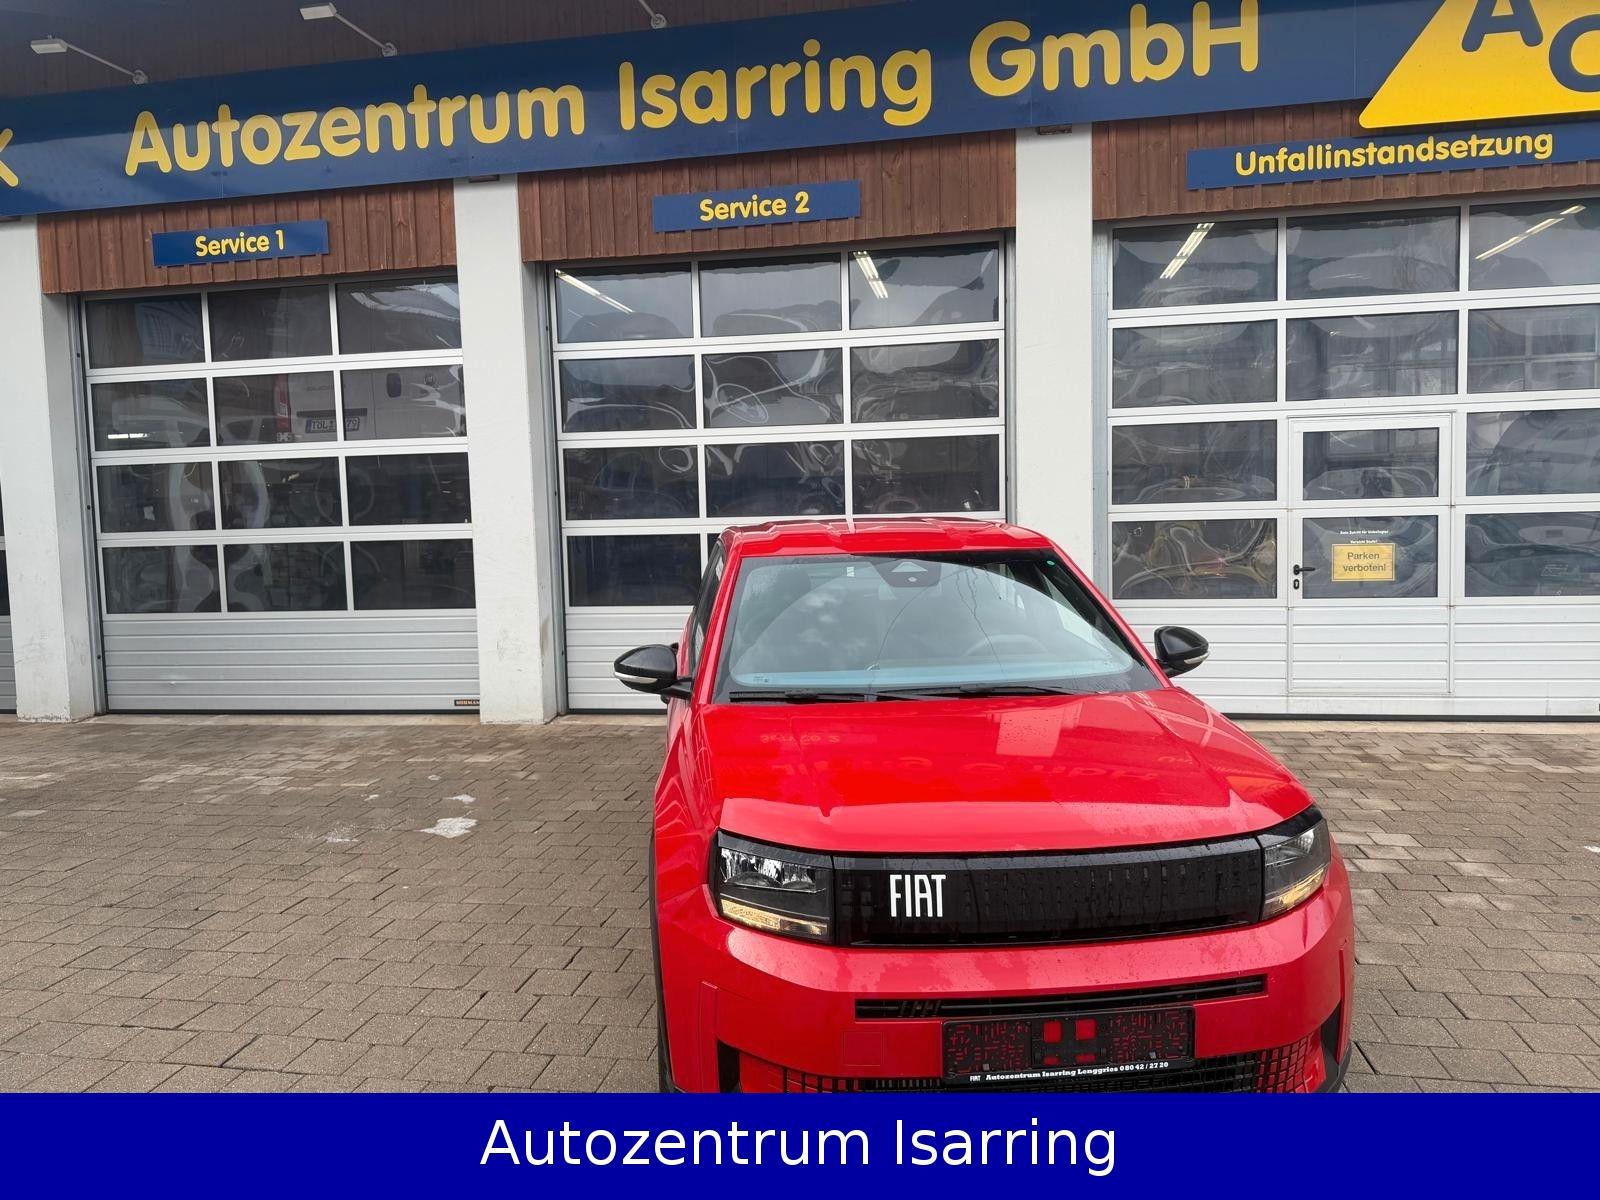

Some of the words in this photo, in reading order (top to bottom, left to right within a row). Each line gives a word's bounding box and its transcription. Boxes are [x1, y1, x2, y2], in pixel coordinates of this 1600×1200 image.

[125, 86, 586, 176] Autozentrum
[620, 40, 933, 127] Isarring
[970, 0, 1260, 97] GmbH
[1234, 133, 1554, 177] Unfallinstandsetzung
[699, 194, 787, 221] Service
[795, 191, 810, 214] 2
[195, 232, 270, 257] Service
[275, 229, 285, 250] 1
[1343, 563, 1387, 572] verboten!
[1347, 551, 1380, 560] Parken
[889, 874, 947, 918] FIAT
[985, 1072, 1041, 1081] Autozentrum
[1041, 1069, 1077, 1077] Isarring
